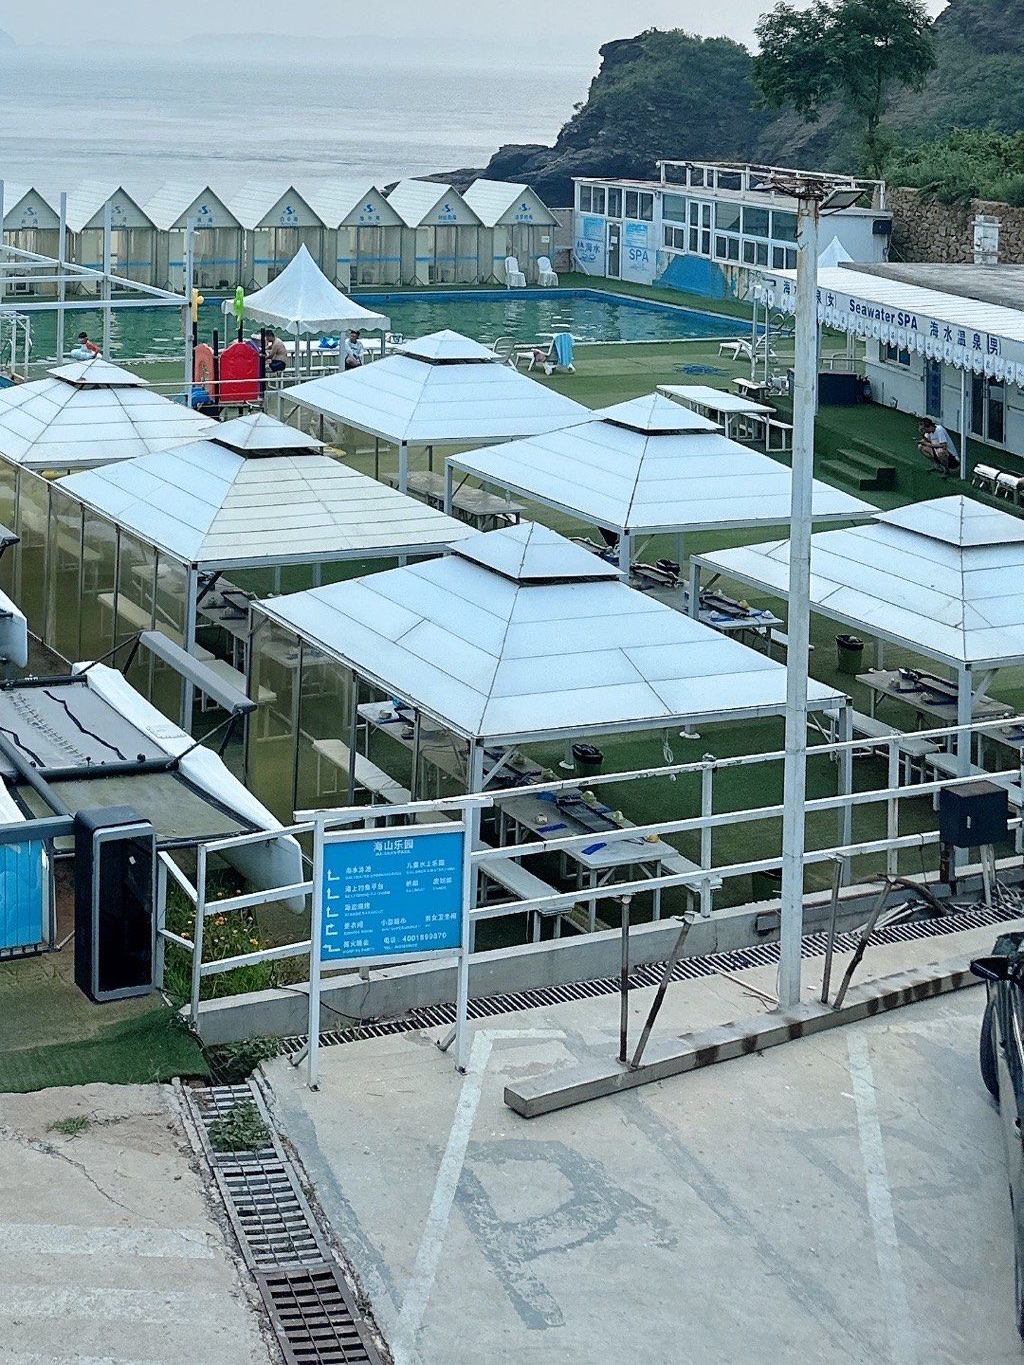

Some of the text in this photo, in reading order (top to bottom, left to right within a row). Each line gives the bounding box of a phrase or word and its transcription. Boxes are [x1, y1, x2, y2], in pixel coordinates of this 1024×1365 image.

[629, 248, 649, 262] SPA
[849, 299, 896, 323] Seawater
[897, 313, 918, 331] SPA
[373, 838, 413, 851] 海山乐园
